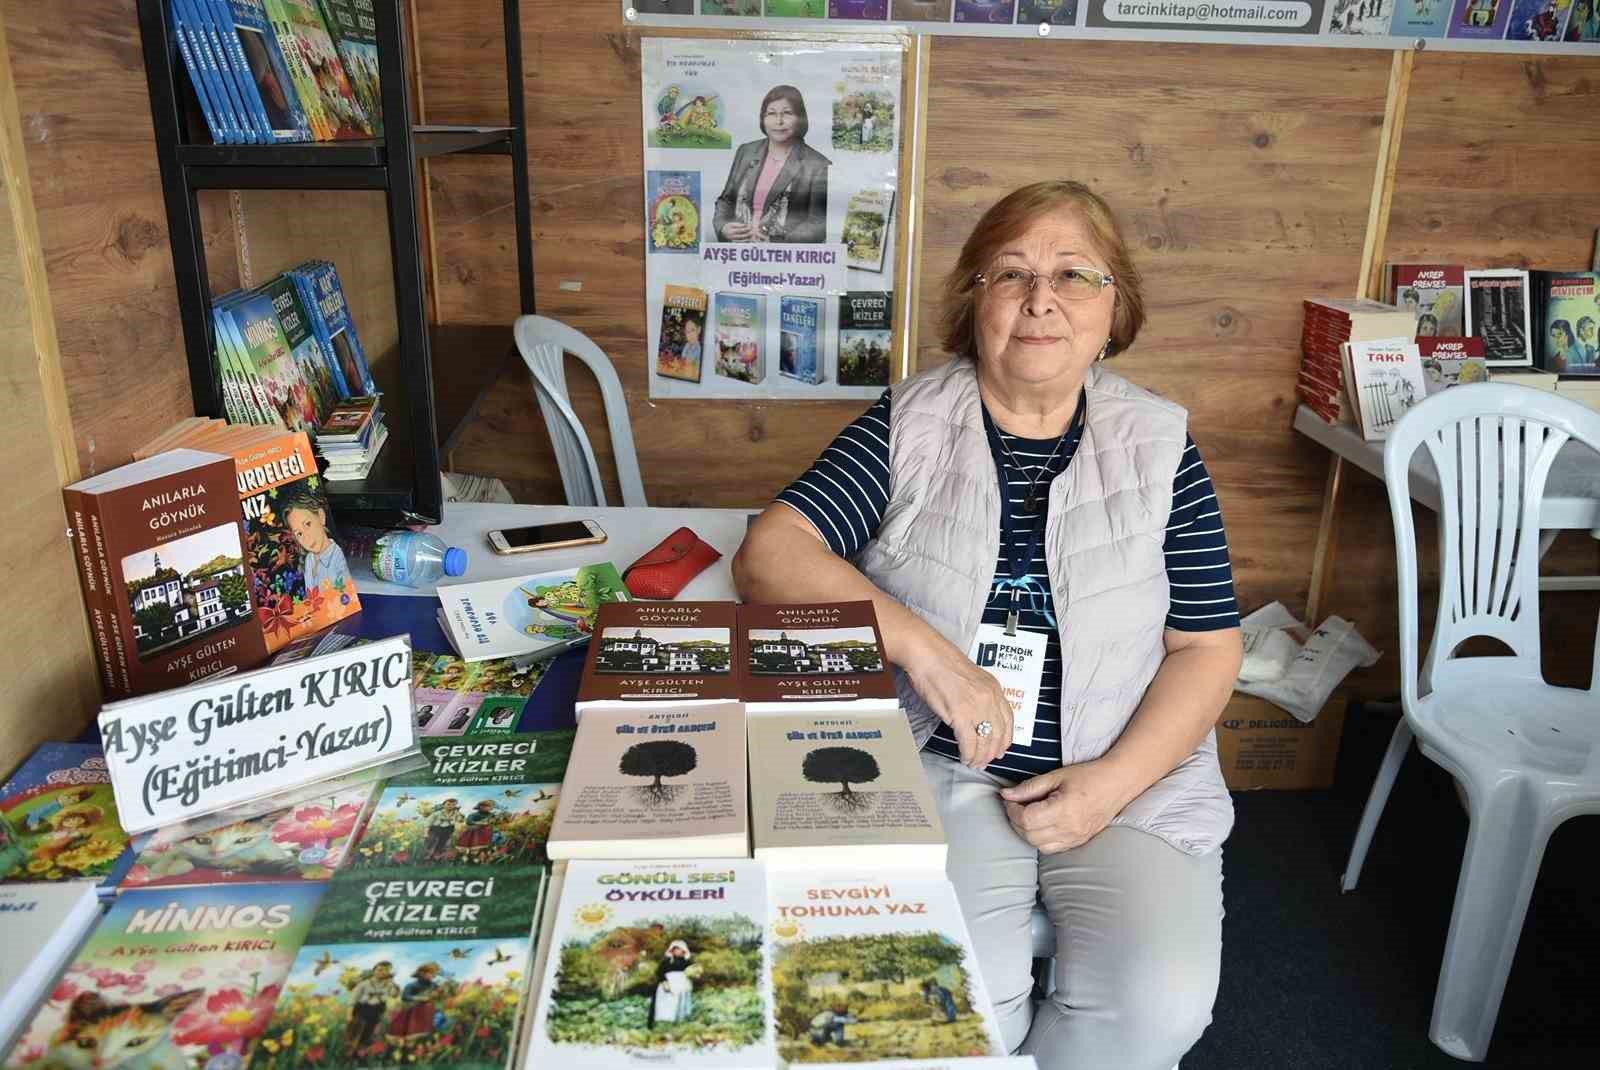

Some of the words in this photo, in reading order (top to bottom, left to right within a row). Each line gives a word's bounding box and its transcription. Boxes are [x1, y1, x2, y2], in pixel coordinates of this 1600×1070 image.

[1117, 2, 1298, 20] tarcinkitap@hotmail.com
[703, 248, 737, 265] AYŞE
[741, 246, 792, 264] GÜLTEN
[797, 250, 836, 264] KIRICI
[728, 271, 825, 289] (Eğitimci-Yazar)
[1417, 270, 1445, 279] AKREP
[1412, 279, 1447, 289] PRENSES
[852, 309, 885, 321] İKİZLER
[1436, 342, 1464, 352] AKREP
[1366, 352, 1406, 363] TAKA
[1432, 351, 1468, 360] PRENSES
[142, 483, 206, 512] ANILARLA
[242, 494, 267, 520] KIZ
[149, 503, 206, 530] GÖYNÜK
[636, 606, 703, 614] ANILARLA
[639, 612, 699, 622] GÖYNÜK
[775, 607, 841, 616] ANILARLA
[781, 614, 840, 624] GÖYNÜK
[167, 653, 194, 673] AYŞE
[196, 637, 237, 661] GÜLTEN
[999, 643, 1033, 657] PENDİK
[189, 661, 224, 681] KIRICI
[619, 679, 652, 688] AYŞE
[655, 677, 704, 687] GÜLTEN
[777, 680, 809, 689] AYŞE
[812, 677, 860, 687] GÜLTEN
[642, 687, 684, 695] KIRICI
[801, 687, 842, 696] KIRICI
[102, 713, 177, 763] Ayşe
[188, 683, 293, 746] Gülten
[301, 650, 411, 707] KIRICI
[432, 739, 537, 760] ÇEVRECİ
[141, 703, 392, 816] (Eğitimci-Yazar)
[432, 757, 527, 775] İKİZLER
[597, 871, 683, 886] GÖNÜL
[687, 869, 736, 884] SESİ
[364, 876, 495, 904] ÇEVRECİ
[604, 886, 726, 902] ÖYKÜLERİ
[807, 884, 892, 901] SEVGİYİ
[125, 901, 292, 935] MİNNOŞ
[362, 901, 481, 924] İKİZLER
[777, 904, 881, 917] TOHUMA
[884, 903, 929, 914] YAZ
[365, 928, 393, 938] Ayşe
[395, 926, 434, 937] Gülten
[436, 925, 479, 936] KIRICI
[111, 944, 158, 957] Ayşe
[164, 943, 219, 954] Gülten
[223, 940, 276, 953] KIRICI
